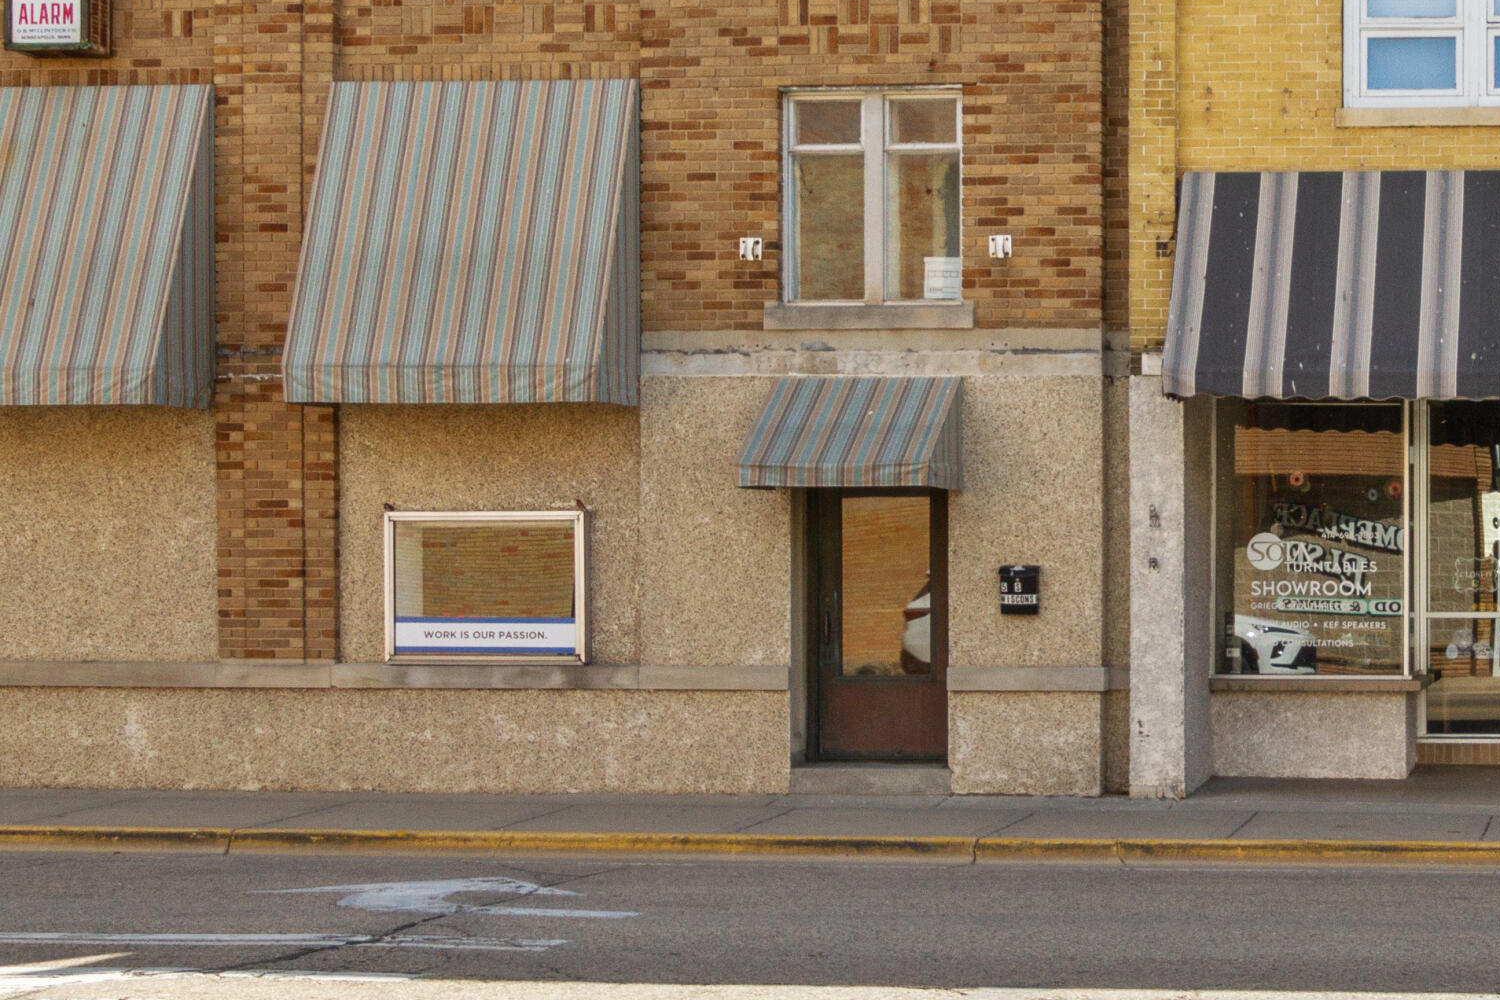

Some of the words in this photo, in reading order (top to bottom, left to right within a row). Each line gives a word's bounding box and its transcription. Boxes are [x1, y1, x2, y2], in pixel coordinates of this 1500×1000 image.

[18, 3, 74, 25] ALARM
[1284, 561, 1378, 573] TURNTABLES
[1250, 580, 1372, 596] SHOWROOM
[1342, 620, 1386, 630] SPEAKERS
[423, 630, 457, 640] WORK
[460, 630, 469, 640] IS
[472, 630, 496, 640] OUR
